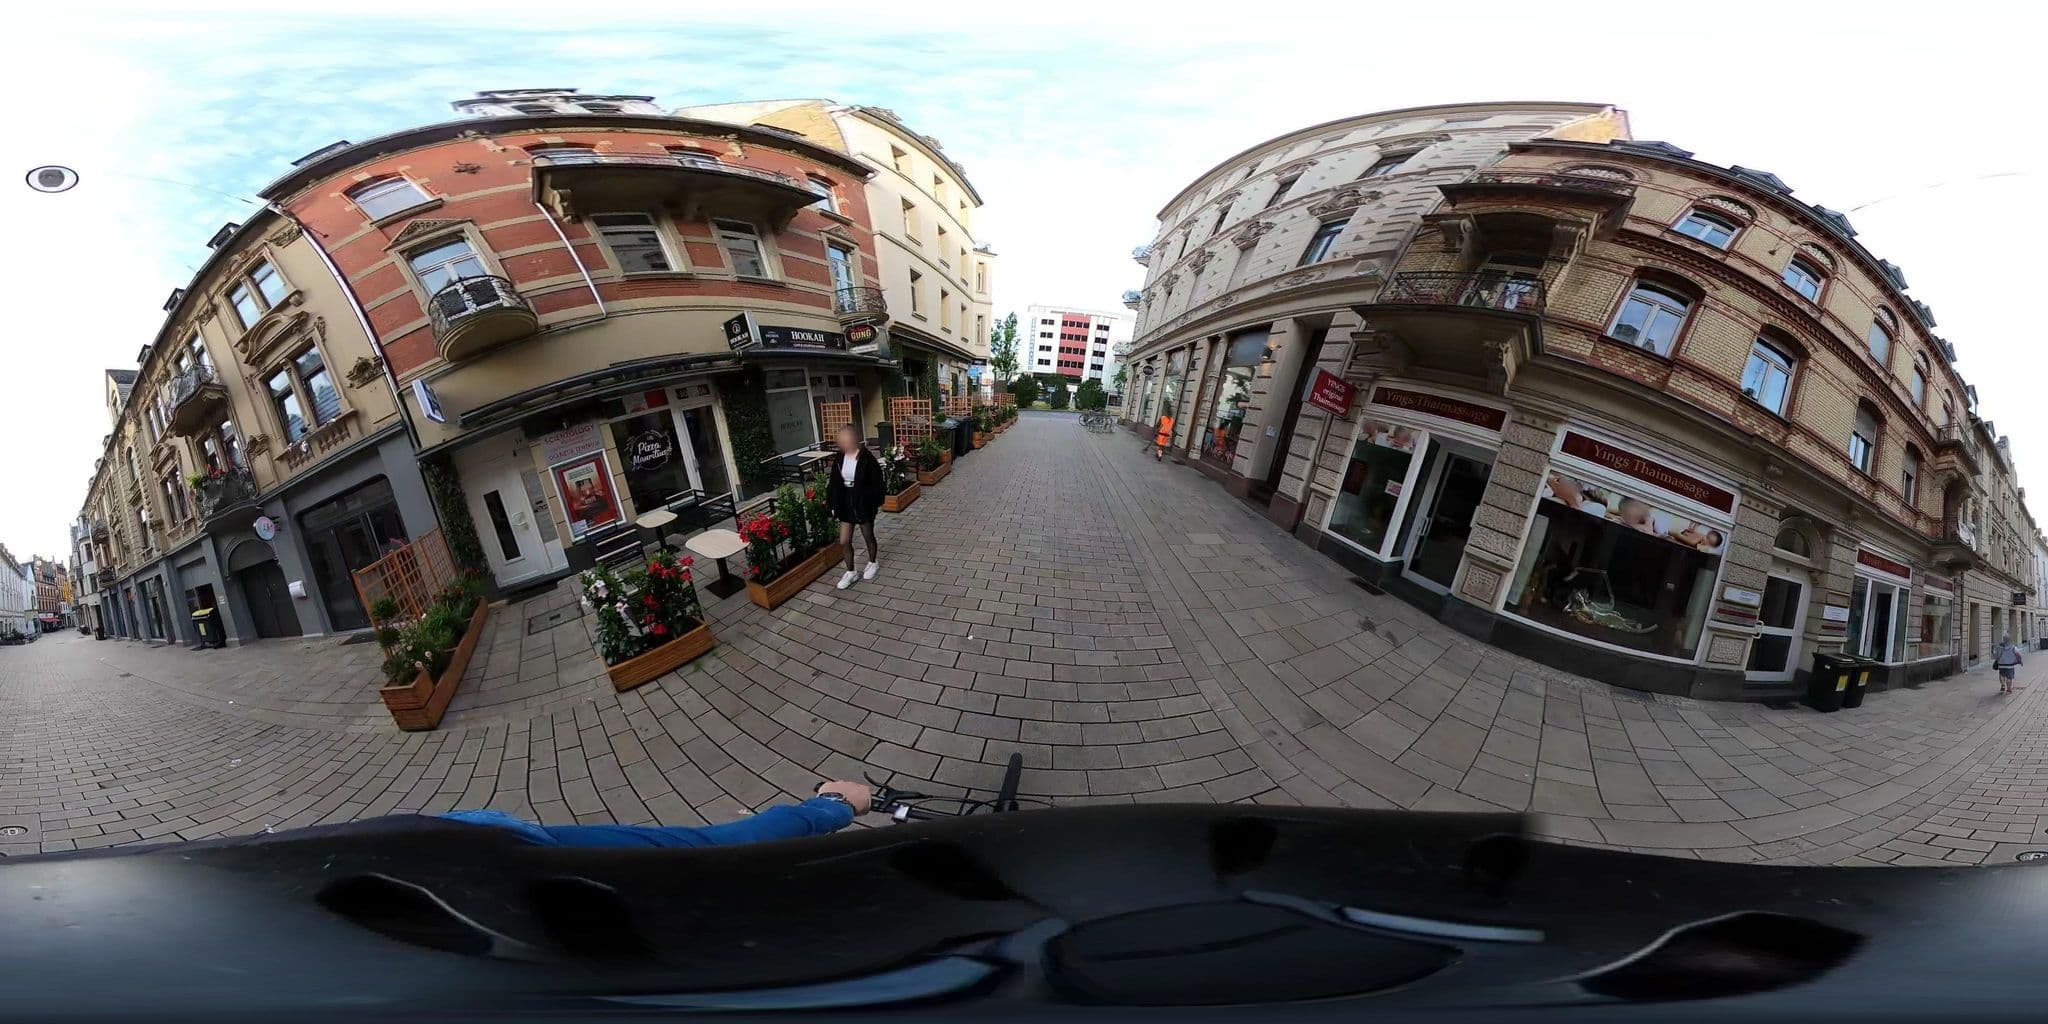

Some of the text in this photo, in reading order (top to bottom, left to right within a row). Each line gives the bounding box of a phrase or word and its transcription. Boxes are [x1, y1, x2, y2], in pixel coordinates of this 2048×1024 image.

[791, 331, 825, 342] HOOKAH
[1386, 390, 1490, 423] Yings Thaimassage
[638, 442, 662, 455] Pizza
[1593, 444, 1710, 499] Yings Thaimassage
